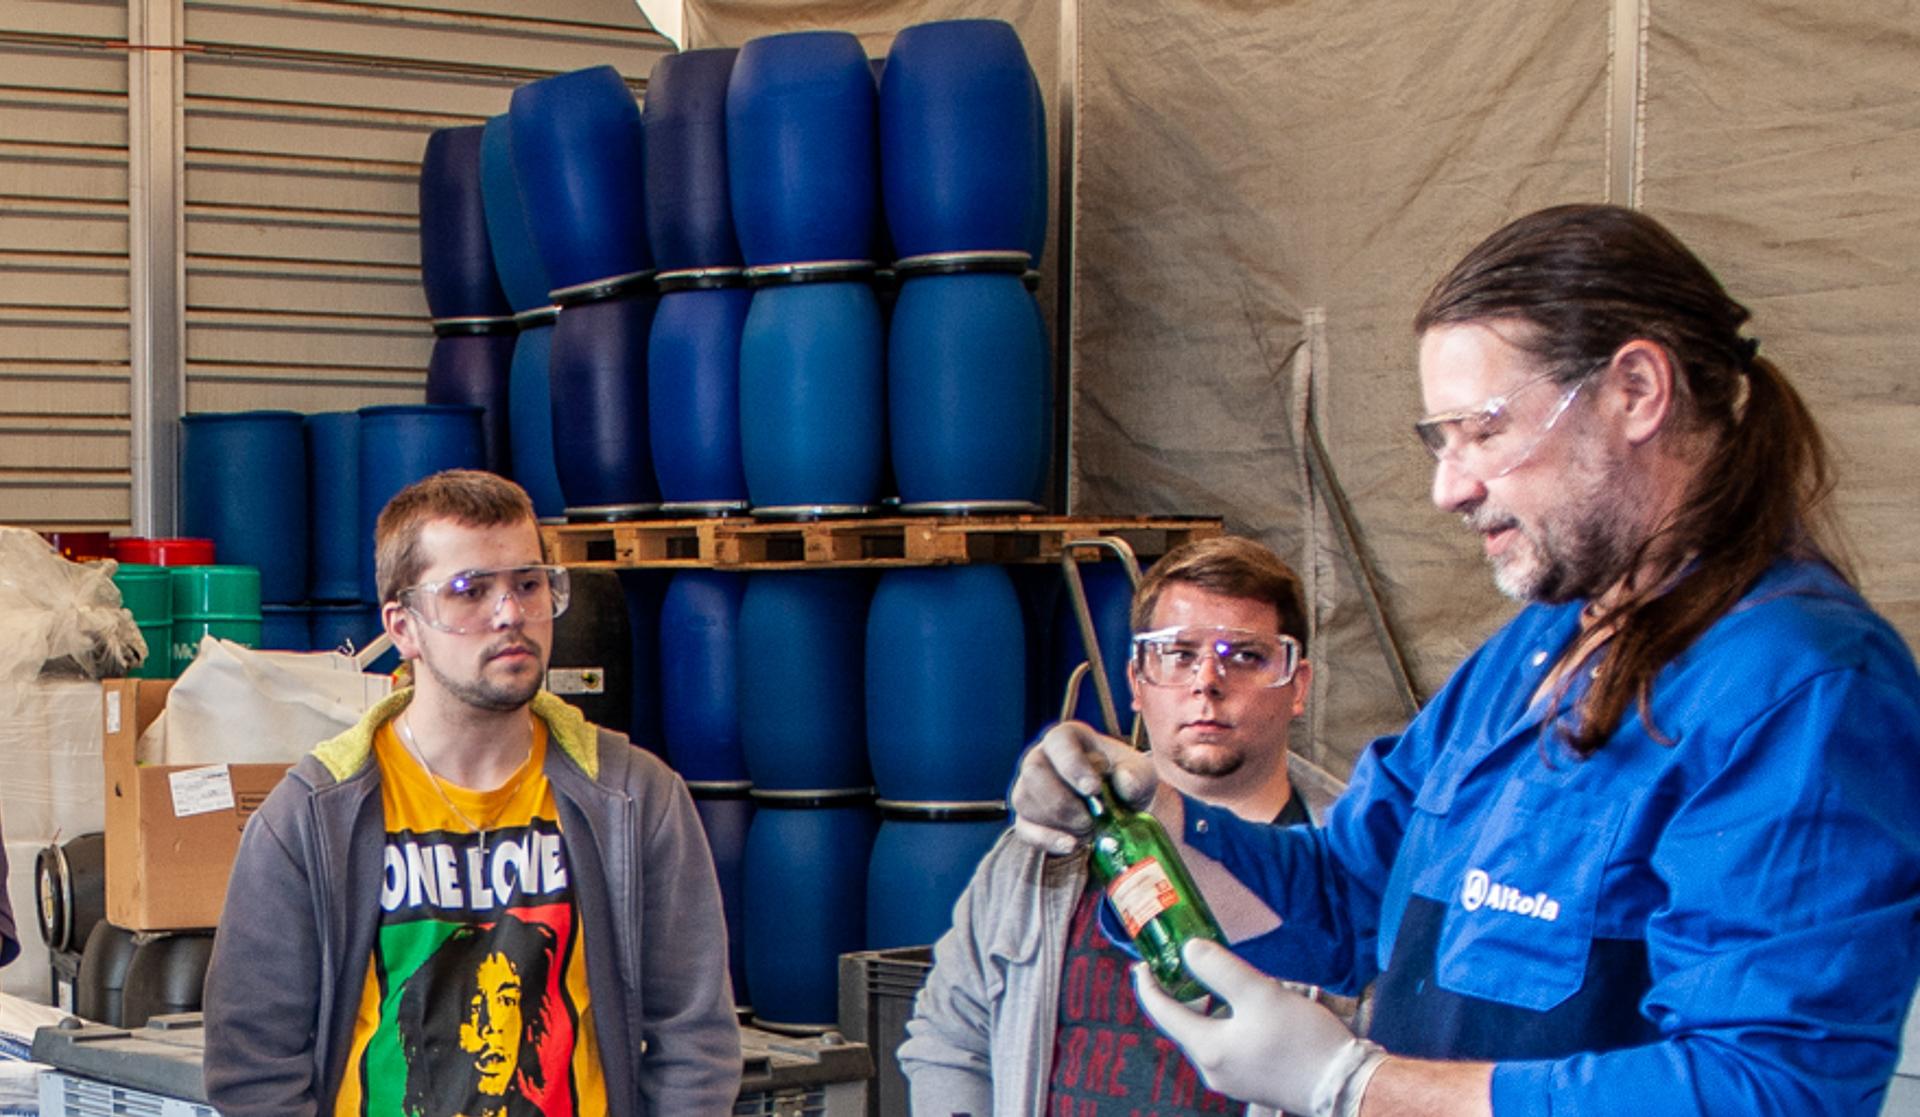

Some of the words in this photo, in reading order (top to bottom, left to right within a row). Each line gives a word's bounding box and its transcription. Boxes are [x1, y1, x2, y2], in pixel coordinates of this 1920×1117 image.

[381, 842, 464, 911] ONE
[466, 830, 567, 909] LOVE
[1484, 882, 1560, 921] Altola
[1053, 1027, 1139, 1096] ORE
